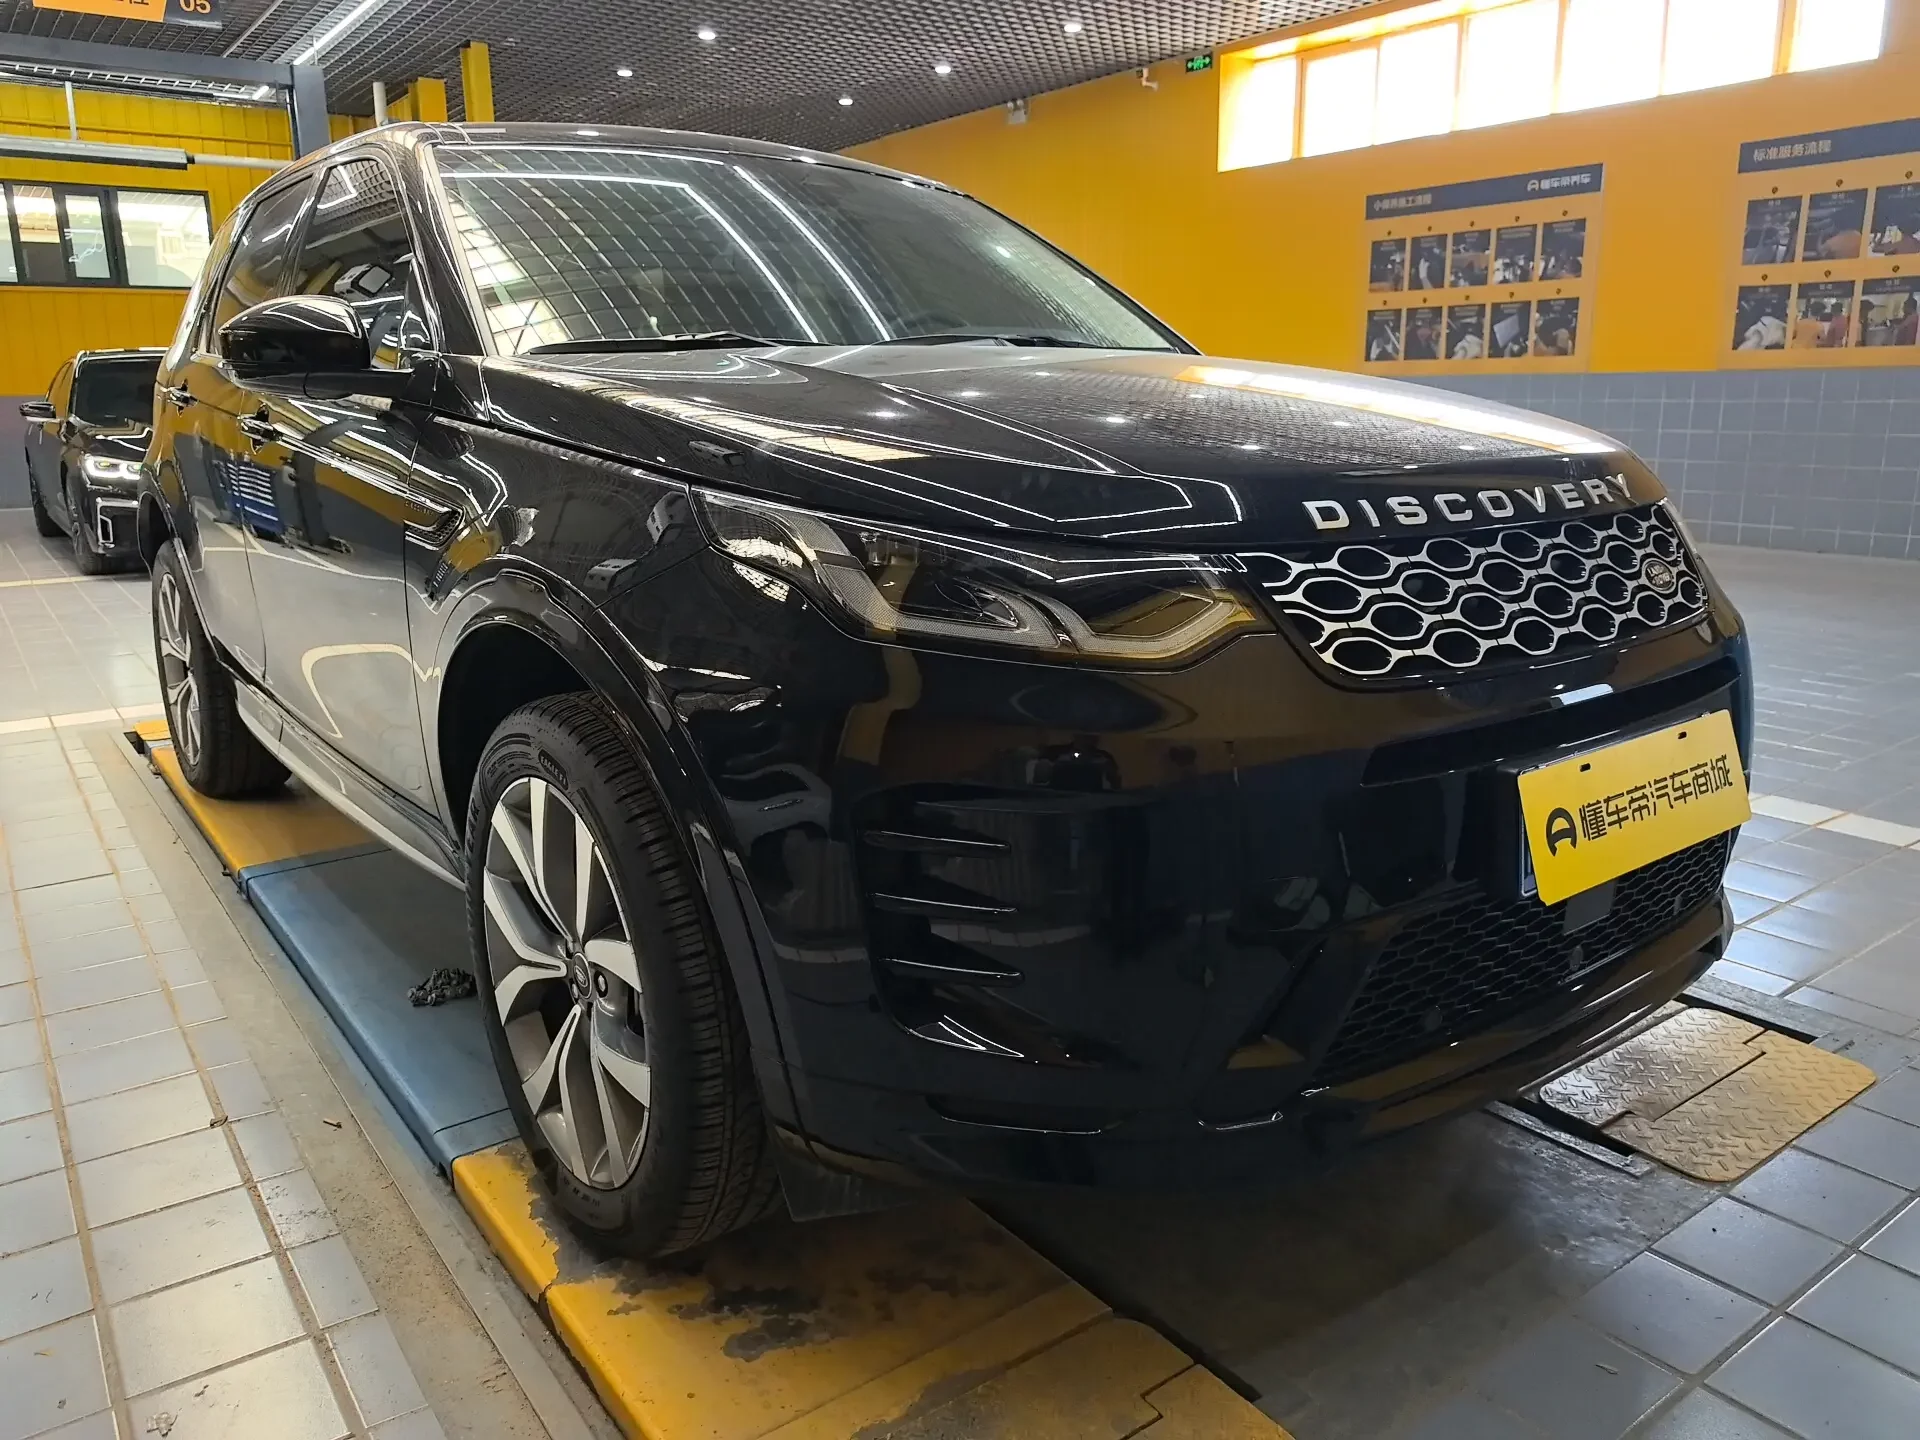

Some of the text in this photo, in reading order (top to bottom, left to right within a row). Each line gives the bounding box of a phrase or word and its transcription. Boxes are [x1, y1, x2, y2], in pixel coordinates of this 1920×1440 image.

[1753, 139, 1832, 162] 标准服务流程
[1302, 473, 1633, 530] DISCOVERY
[1578, 753, 1733, 842] 懂车帝汽车商城
